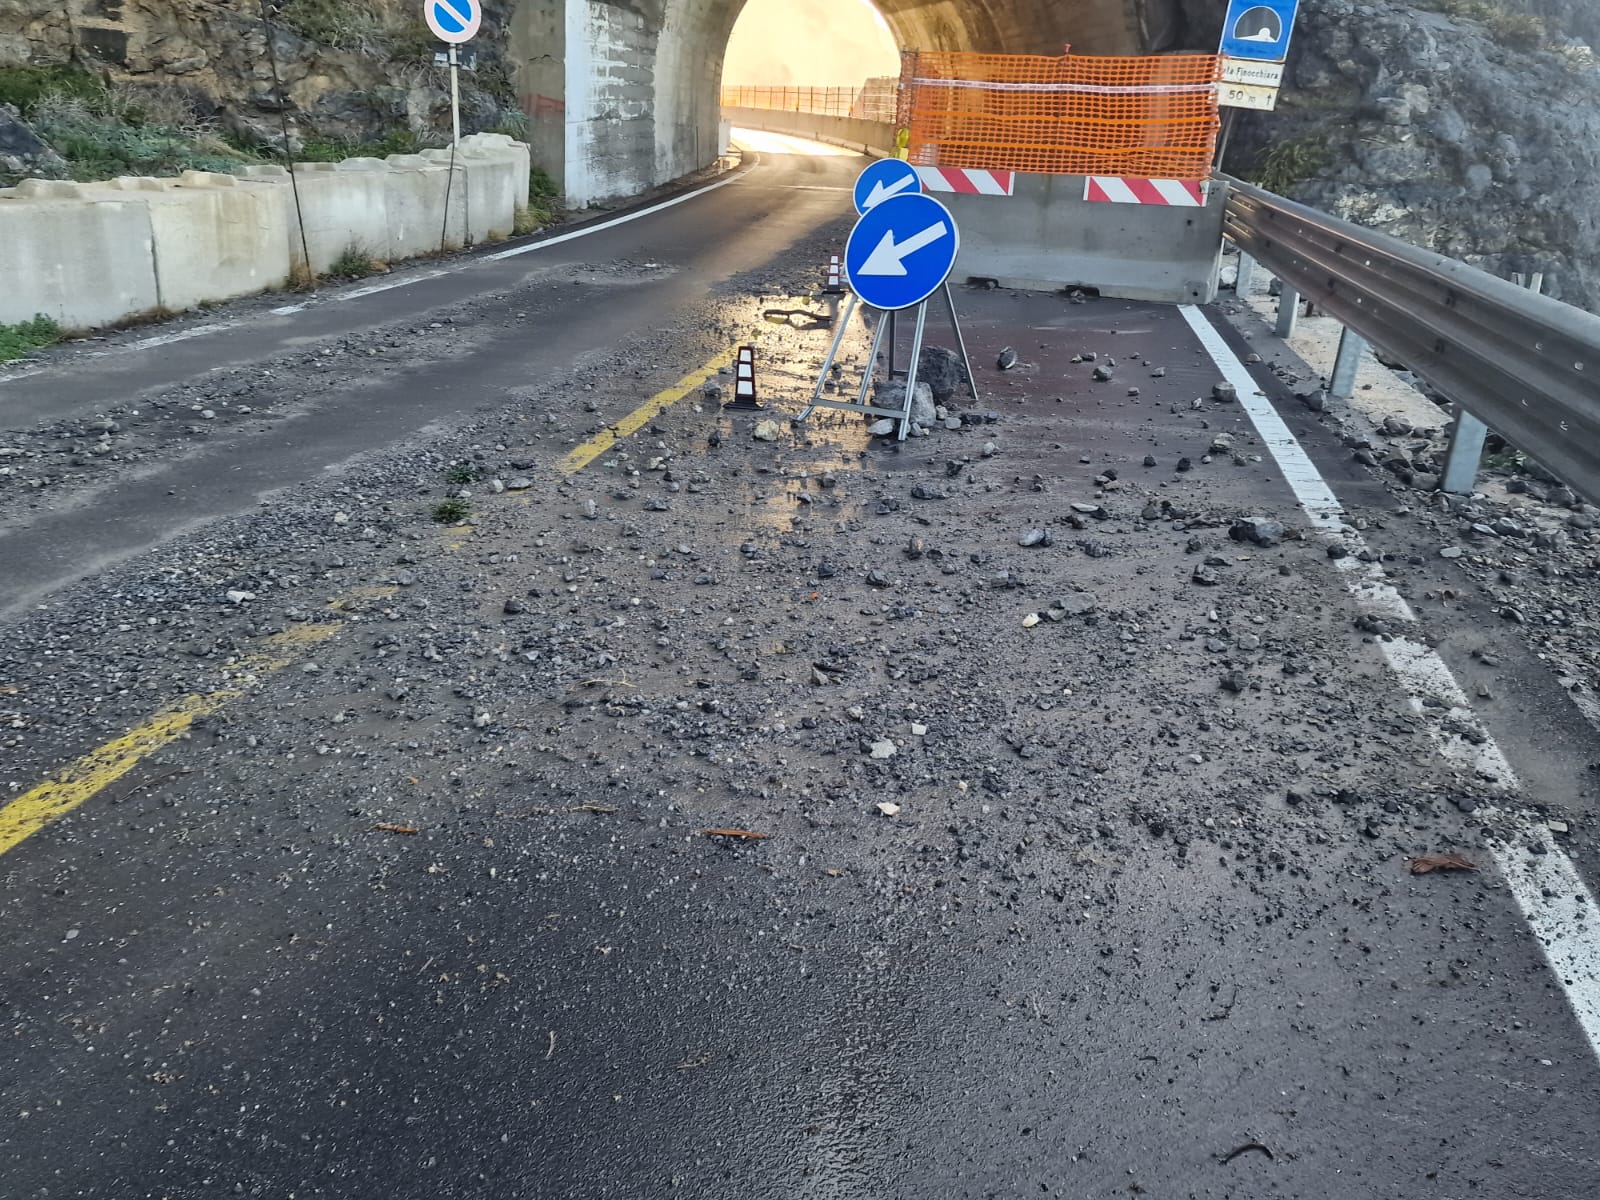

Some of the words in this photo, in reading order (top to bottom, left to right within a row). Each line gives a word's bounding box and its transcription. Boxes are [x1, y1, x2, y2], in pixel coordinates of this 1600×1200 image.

[1236, 67, 1278, 79] Finocchiara
[1228, 90, 1243, 100] 50
[1248, 95, 1256, 103] m
